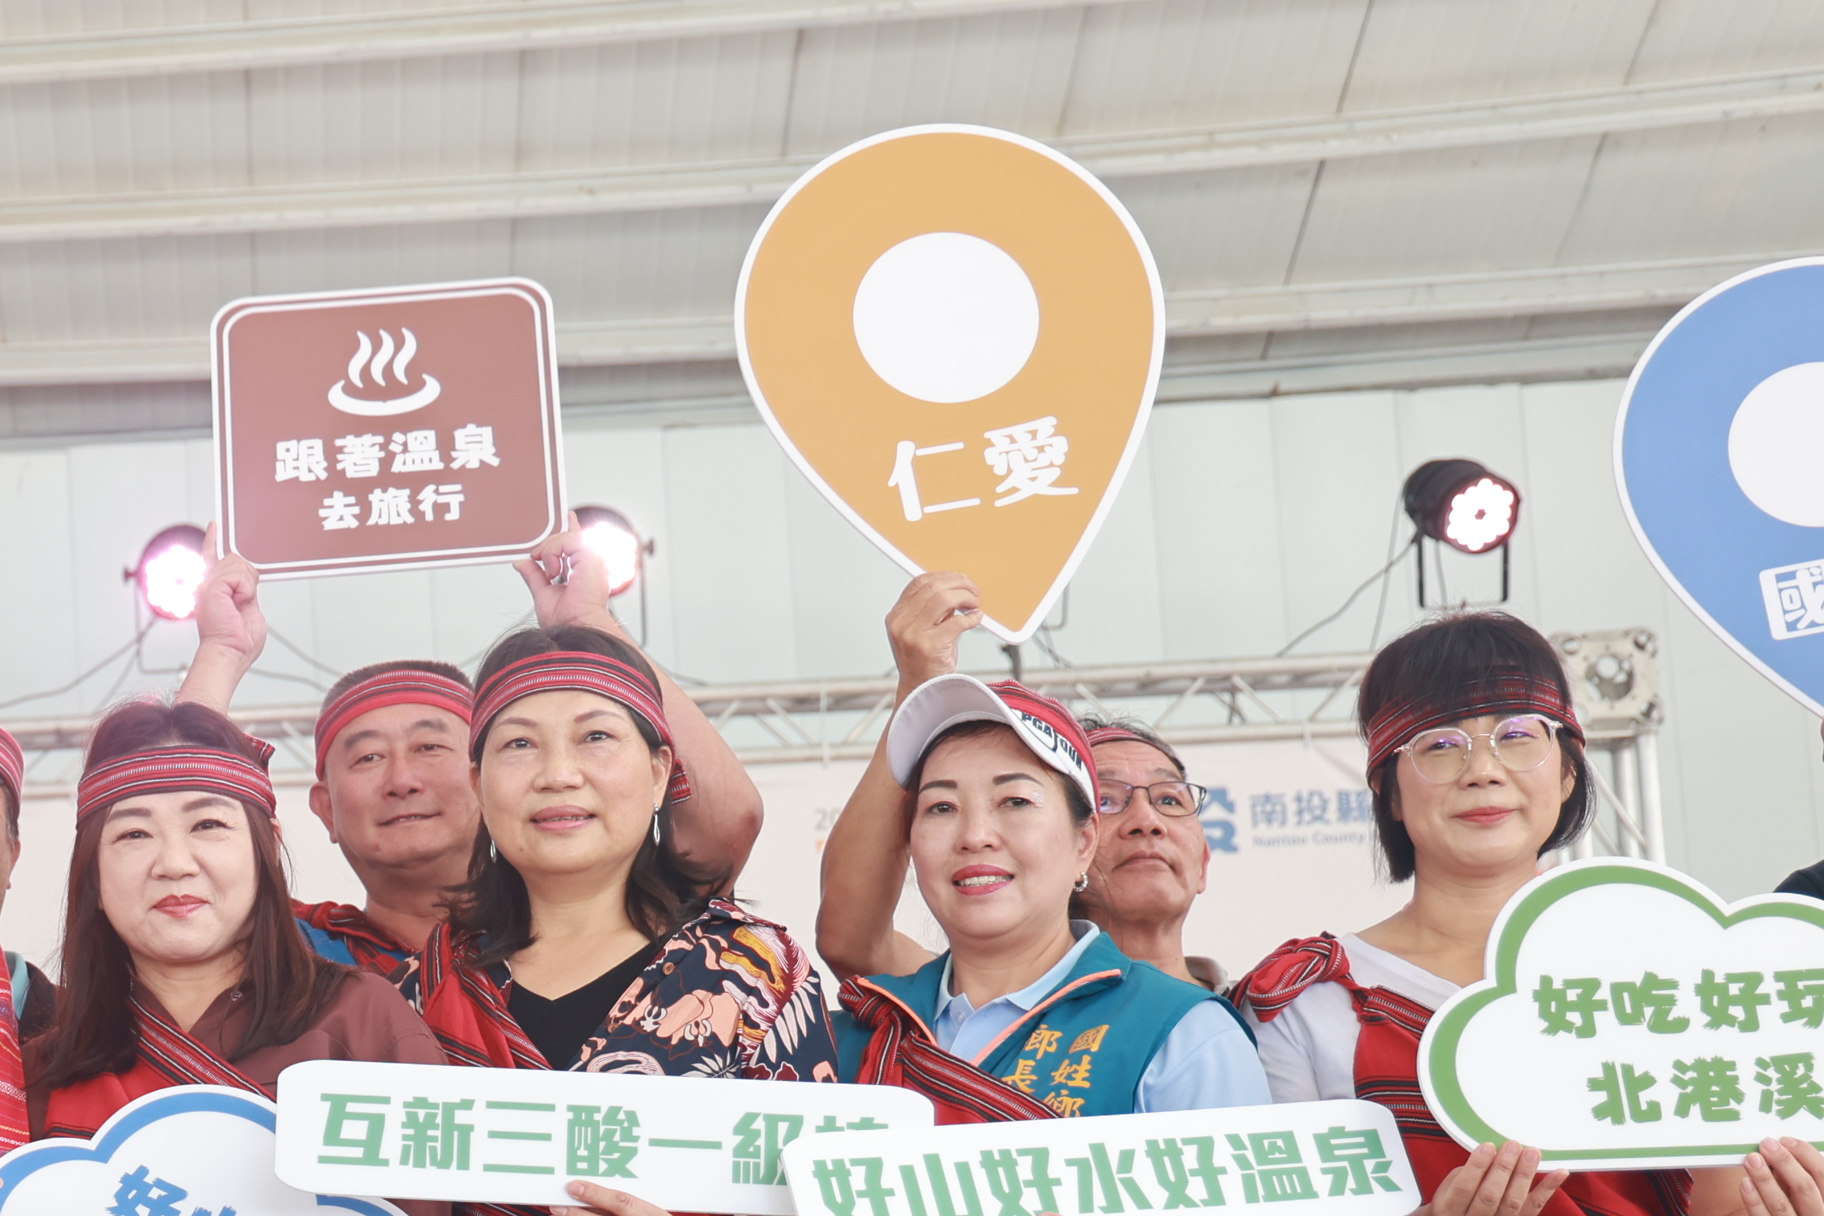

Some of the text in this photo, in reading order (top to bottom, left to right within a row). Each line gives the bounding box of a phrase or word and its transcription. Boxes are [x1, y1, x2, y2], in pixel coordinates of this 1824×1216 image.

[274, 423, 501, 482] 跟著溫泉
[888, 415, 1080, 522] 仁愛
[318, 483, 465, 531] 去旅行
[1586, 1052, 1824, 1126] 北港溪
[318, 1093, 889, 1186] 互新三酸一級
